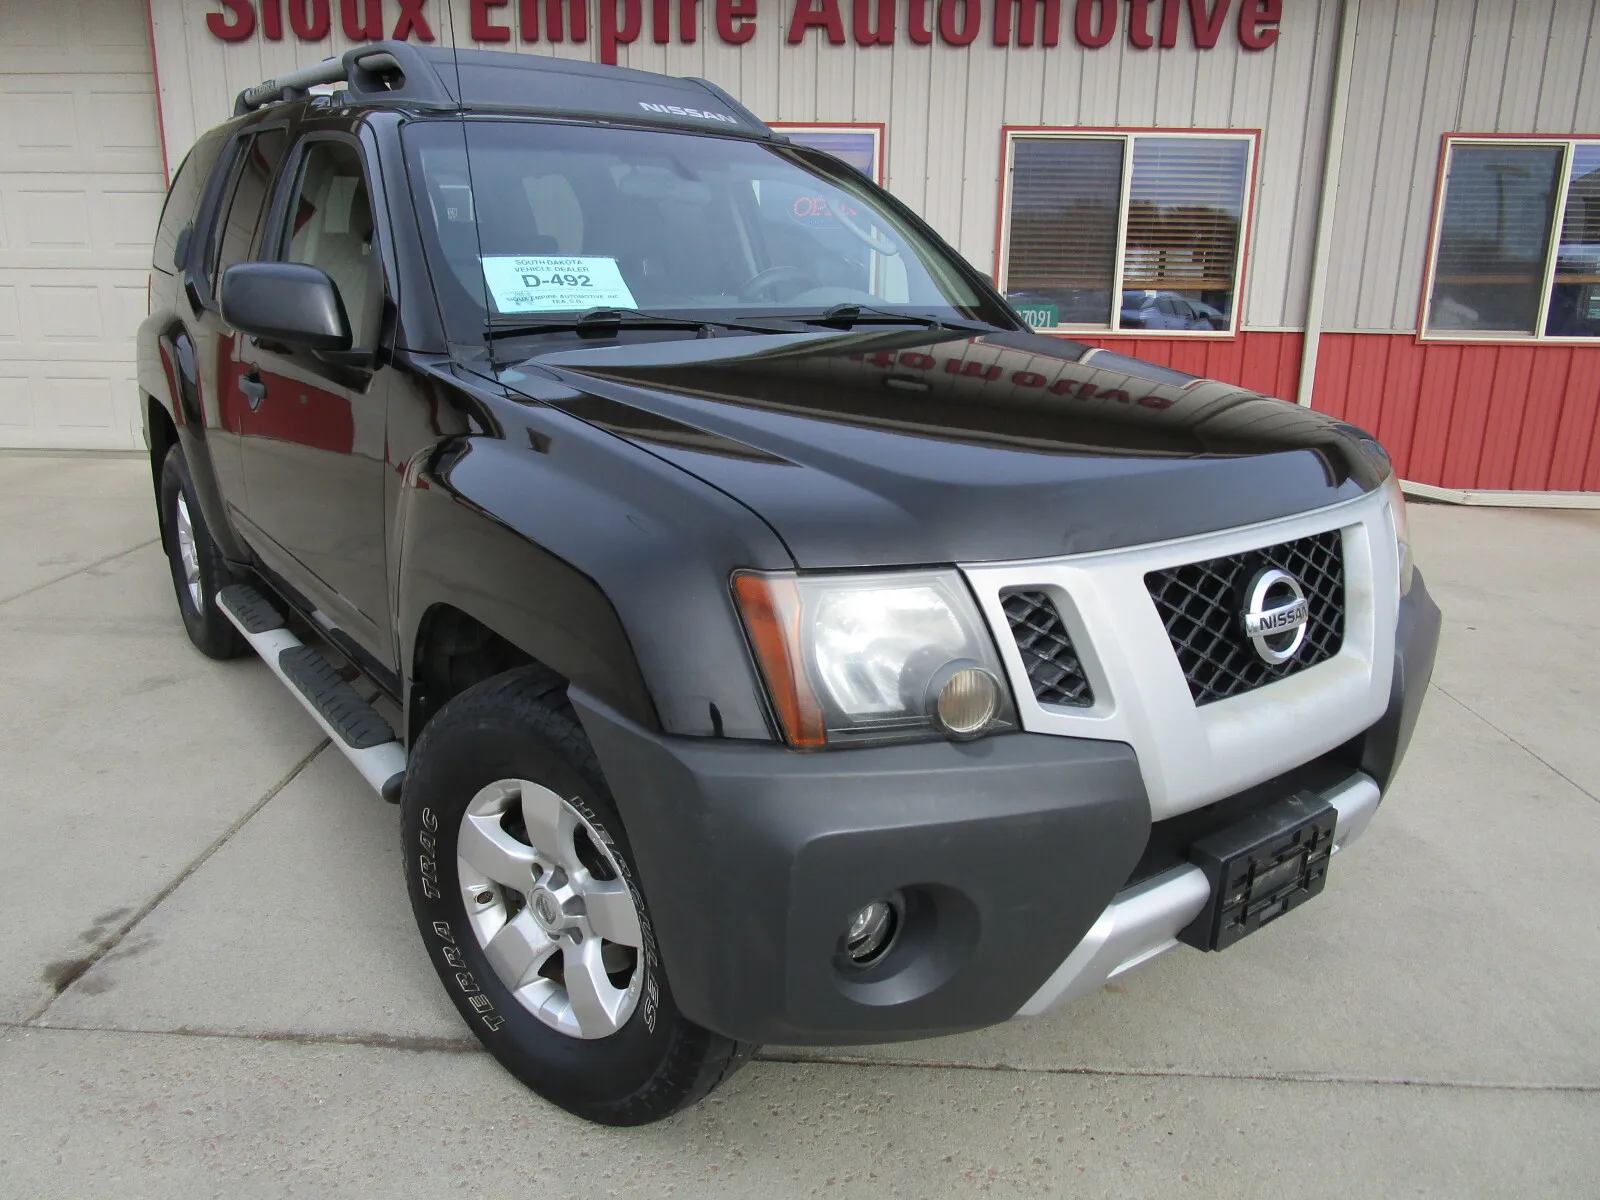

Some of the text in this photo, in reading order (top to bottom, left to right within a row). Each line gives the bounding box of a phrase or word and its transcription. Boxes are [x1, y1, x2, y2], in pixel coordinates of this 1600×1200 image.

[206, 0, 1283, 66] Sioux Empire Automotive
[639, 102, 738, 124] NISSAN
[521, 274, 594, 288] D-492
[1260, 606, 1308, 631] NISSAN
[419, 807, 506, 1032] TERRA TRAC
